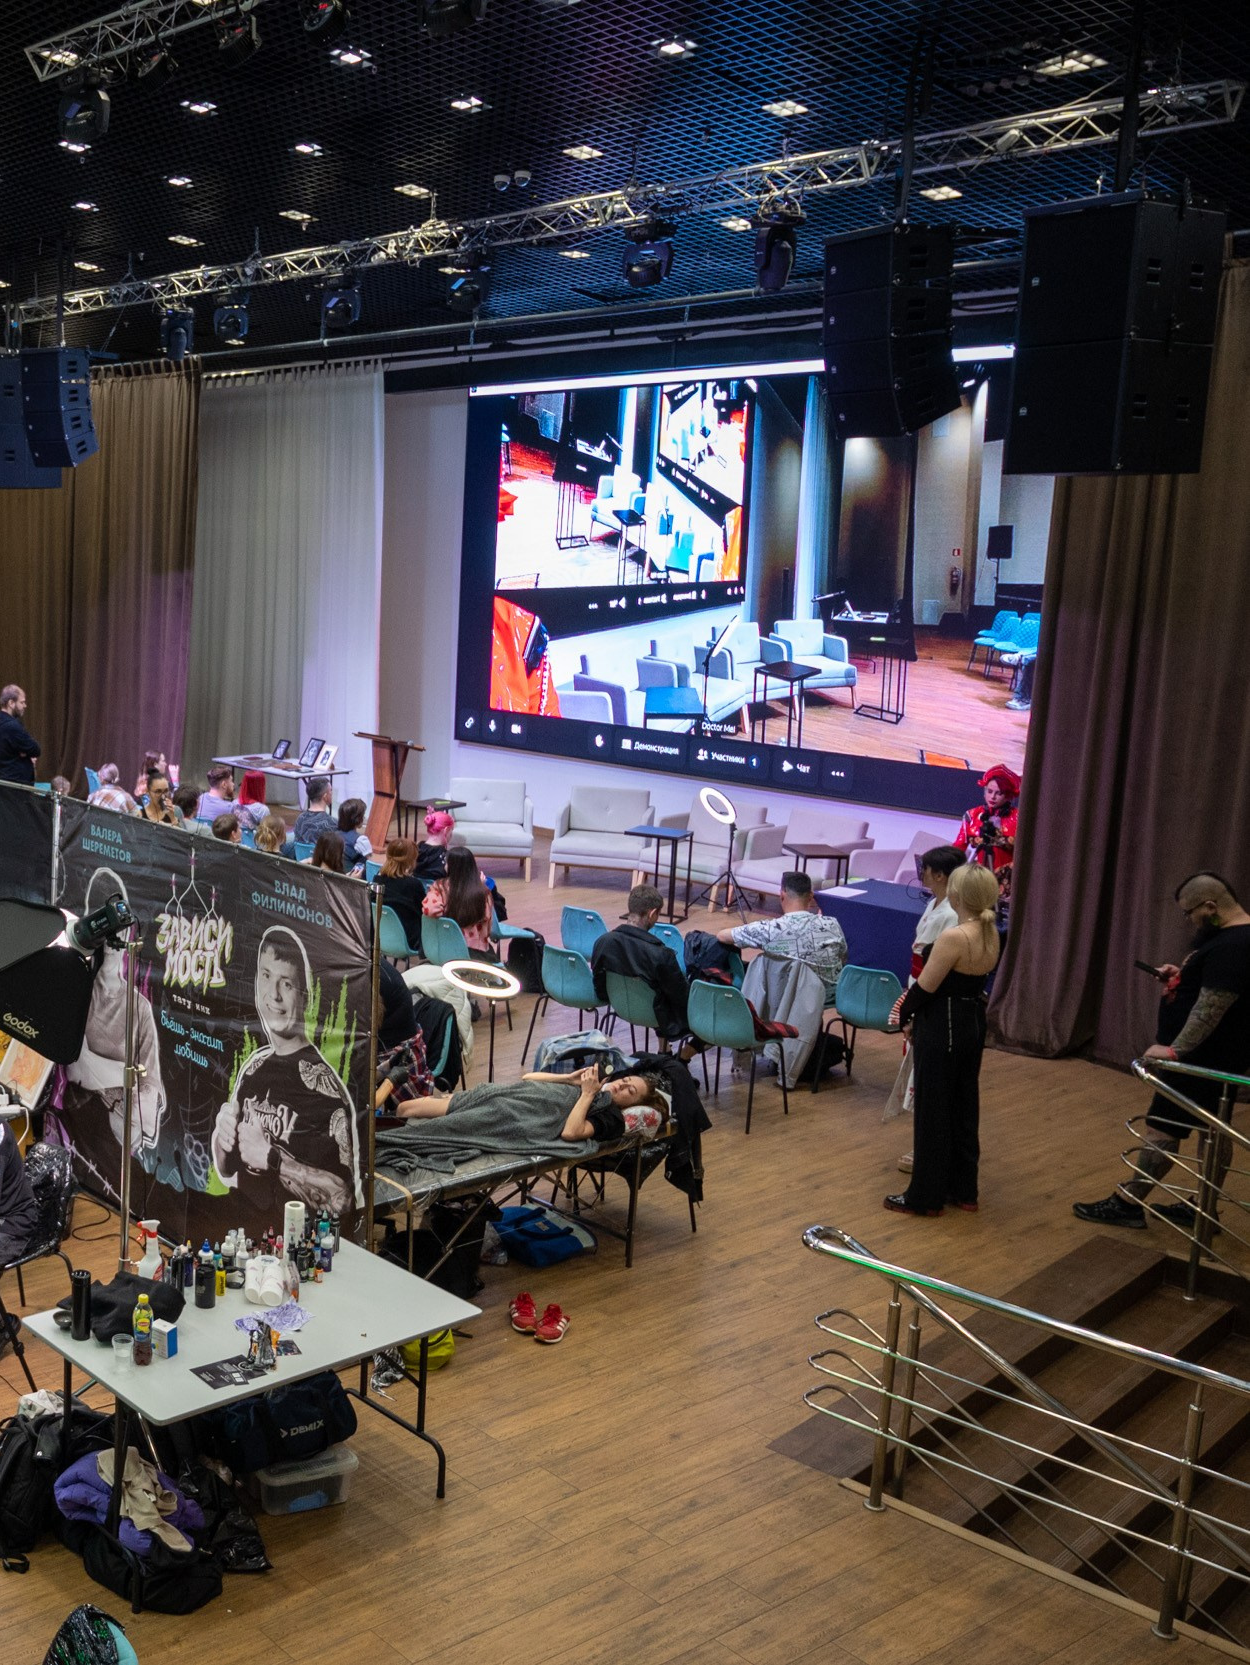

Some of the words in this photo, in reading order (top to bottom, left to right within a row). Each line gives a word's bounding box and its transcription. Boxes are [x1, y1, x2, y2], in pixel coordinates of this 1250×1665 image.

[702, 721, 723, 732] Doctor
[634, 741, 680, 755] Демонстрация
[711, 751, 746, 764] Участники
[796, 763, 811, 773] Чат
[91, 823, 122, 845] ВАЛЕРА
[82, 837, 131, 864] ШЕРЕМЕТОВ
[274, 880, 307, 905] ВЛАД
[251, 891, 333, 929] ФИЛИМОНОВ
[155, 913, 233, 965] ЗАВИСИ
[163, 948, 226, 996] МОСТЬ
[3, 1012, 40, 1039] Godox
[174, 1042, 208, 1068] любишь
[290, 1419, 325, 1437] DEMIX
